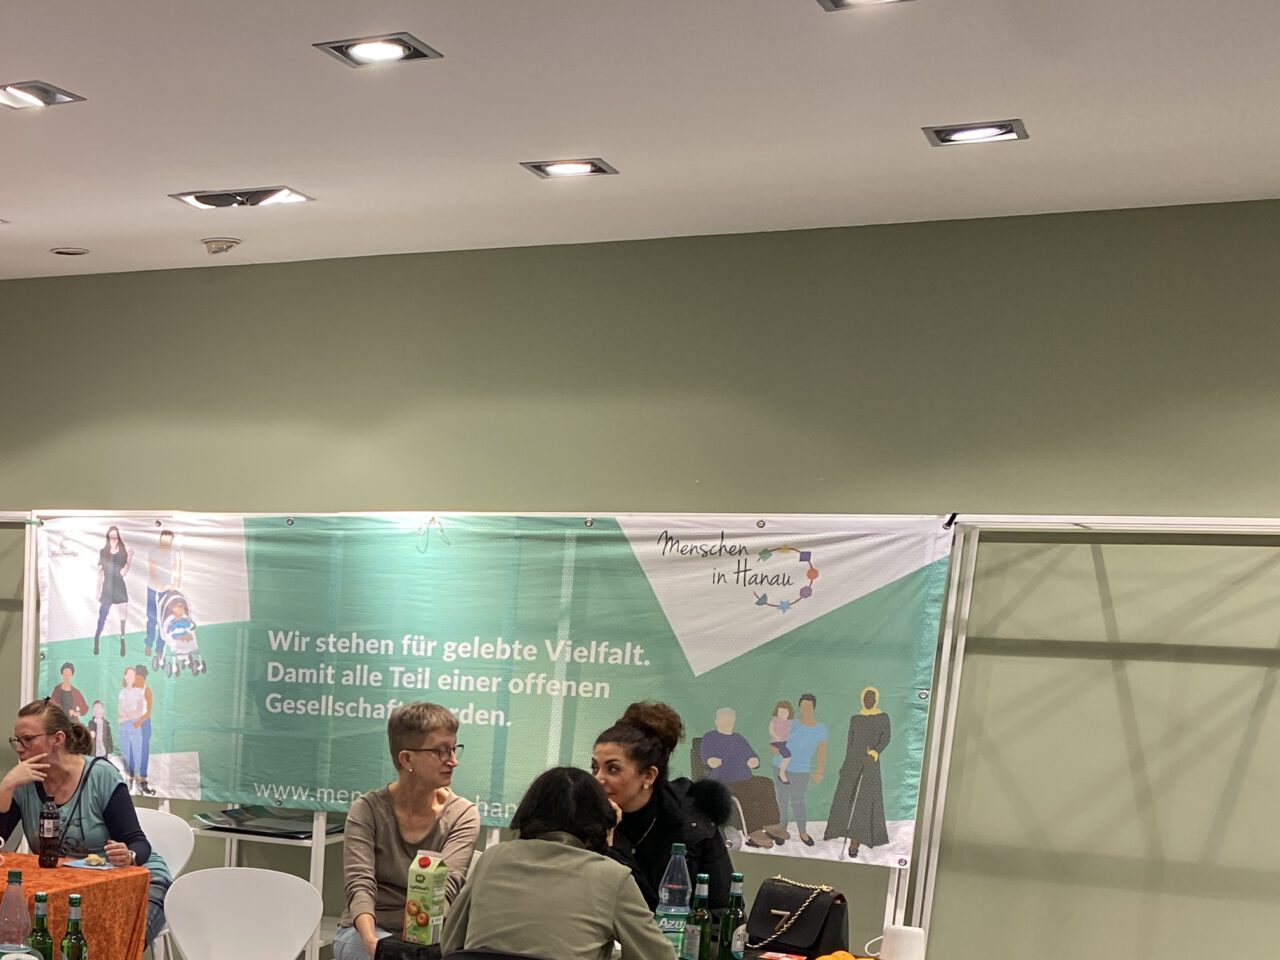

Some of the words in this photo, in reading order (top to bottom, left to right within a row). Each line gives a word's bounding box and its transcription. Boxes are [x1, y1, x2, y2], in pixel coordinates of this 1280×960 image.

[657, 530, 749, 558] Menschen
[712, 568, 727, 585] in
[734, 558, 794, 587] Hanau
[268, 630, 310, 651] Wir
[316, 632, 394, 655] stehen
[401, 634, 437, 657] für
[442, 636, 538, 662] gelebte
[544, 639, 650, 666] Vielfalt.
[267, 661, 335, 684] Damit
[341, 664, 383, 687] alle
[389, 666, 431, 689] Teil
[437, 669, 502, 693] einer
[508, 673, 610, 698] offenen
[265, 693, 404, 719] Gesellschaf
